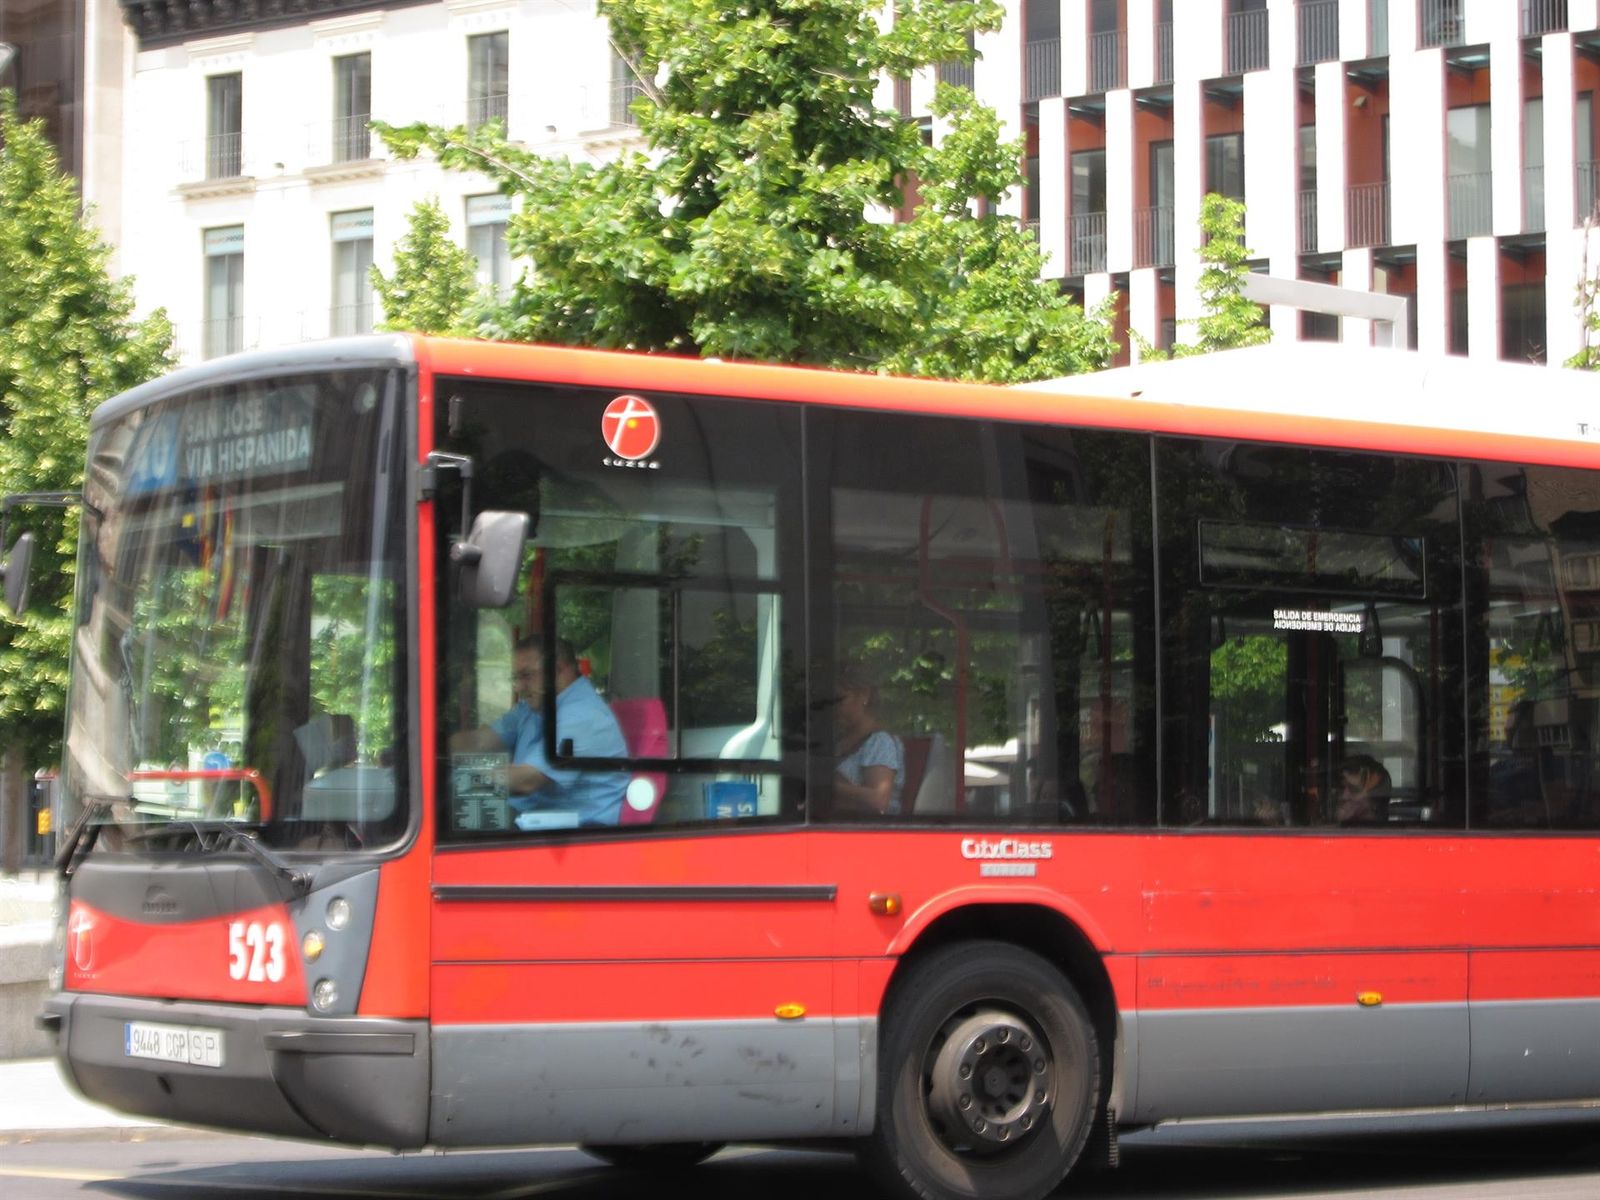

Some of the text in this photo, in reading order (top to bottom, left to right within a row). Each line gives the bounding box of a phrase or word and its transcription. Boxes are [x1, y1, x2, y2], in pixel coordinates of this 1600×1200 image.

[185, 406, 219, 442] SAN
[217, 425, 312, 474] HISPANIDA
[1273, 610, 1361, 623] SALIDA DE EMERGENCIA
[961, 838, 1053, 859] CityClass
[229, 921, 285, 982] 523
[133, 1029, 160, 1055] 9448
[193, 1035, 215, 1061] SP
